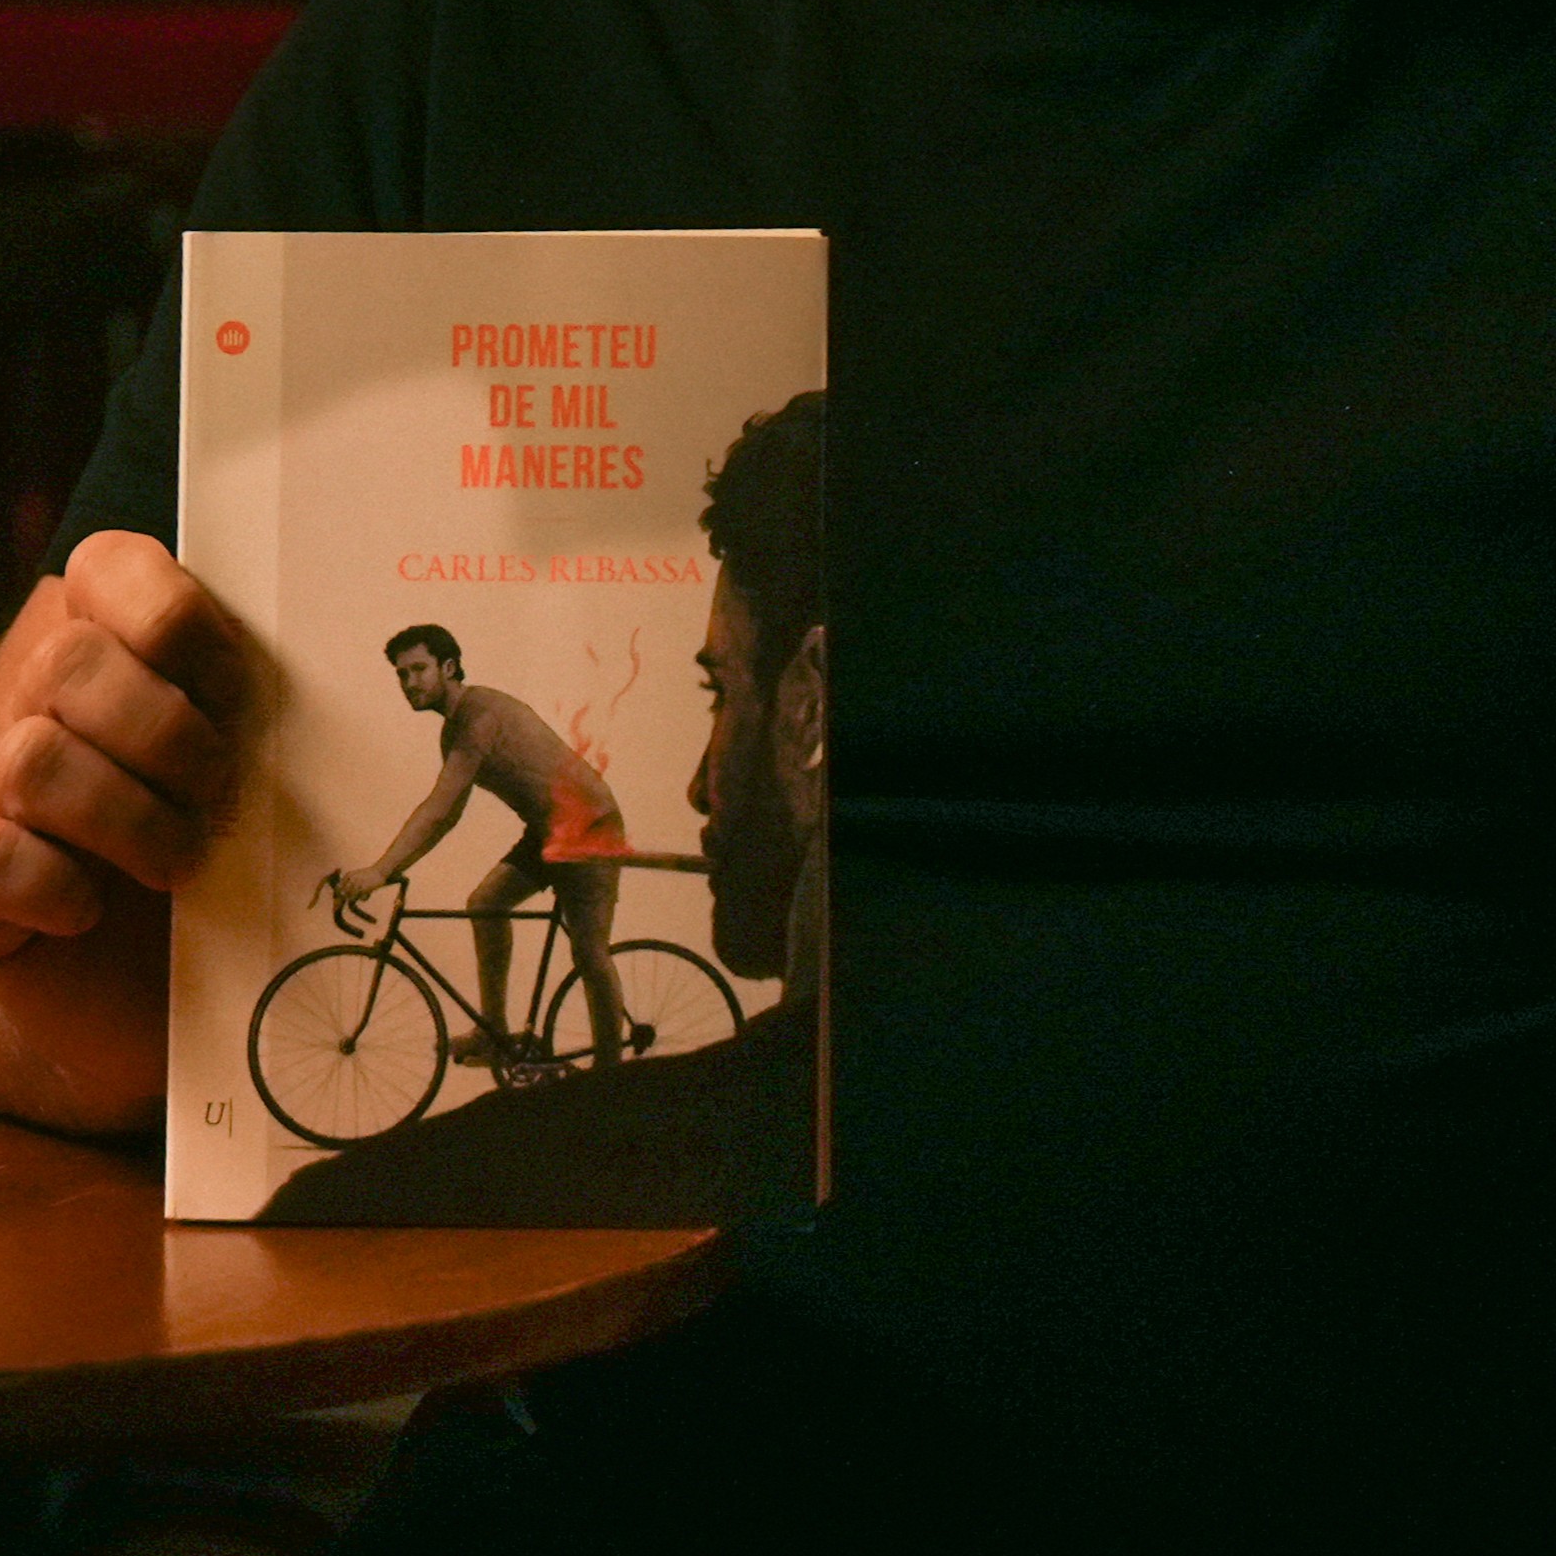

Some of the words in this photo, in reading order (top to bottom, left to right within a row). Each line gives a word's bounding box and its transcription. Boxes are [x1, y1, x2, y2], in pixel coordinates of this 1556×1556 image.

[451, 323, 657, 369] PROMETEU
[489, 384, 537, 428] DE
[550, 384, 619, 429] MIL
[460, 444, 645, 489] MANERES
[396, 553, 537, 582] CARLES
[548, 554, 703, 584] REBASSA
